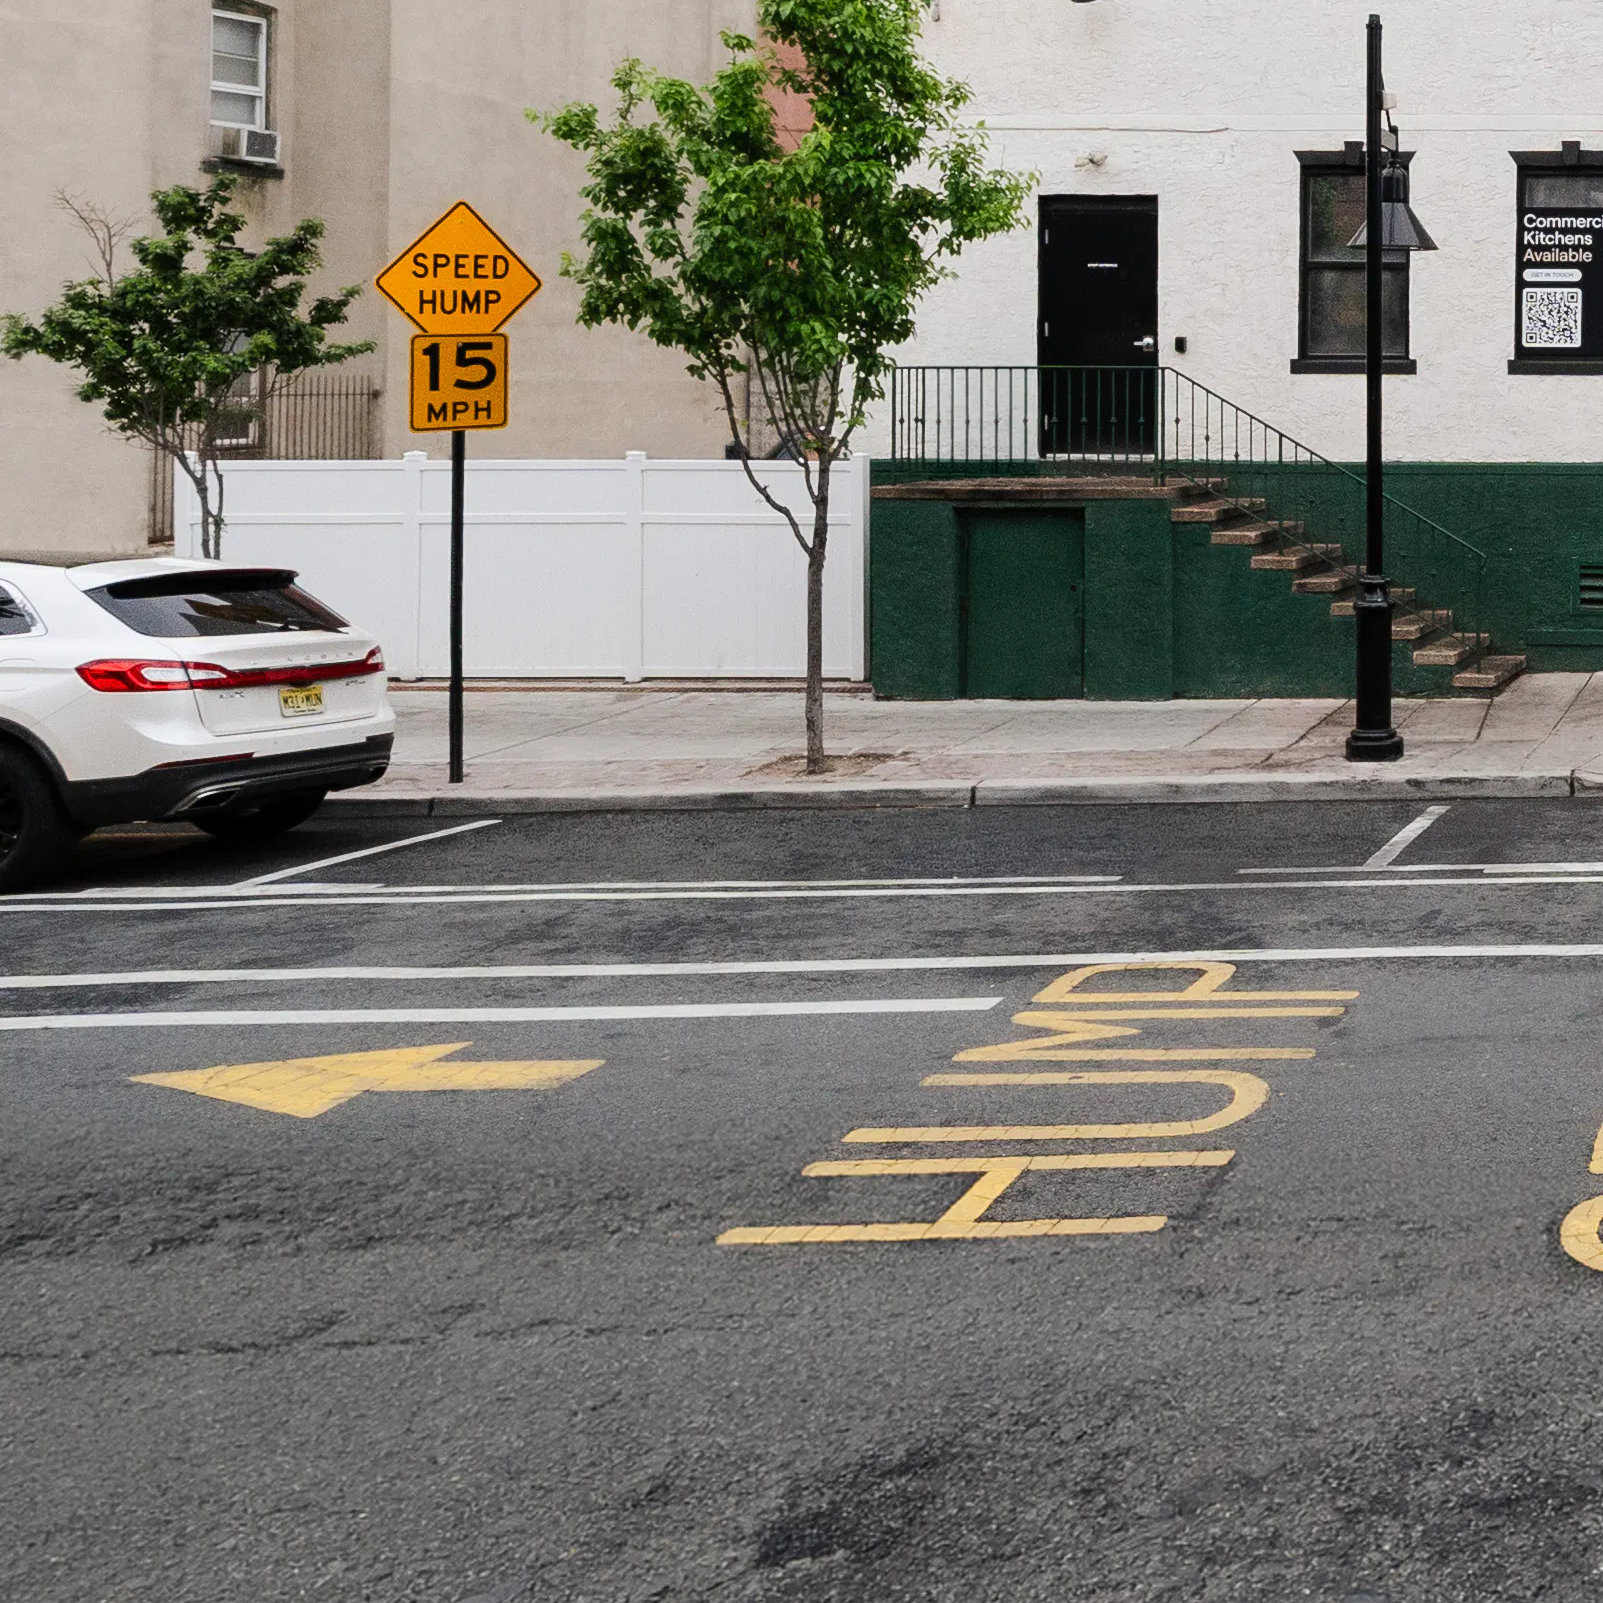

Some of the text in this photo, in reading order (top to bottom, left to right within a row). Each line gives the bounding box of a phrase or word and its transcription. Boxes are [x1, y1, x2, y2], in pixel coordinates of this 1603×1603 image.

[1523, 230, 1593, 245] Kitchens
[411, 252, 510, 280] SPEED
[1523, 247, 1593, 262] Available
[418, 289, 502, 316] HUMP
[421, 341, 497, 392] 15
[426, 400, 492, 423] MPH
[715, 961, 1361, 1246] HUMP
